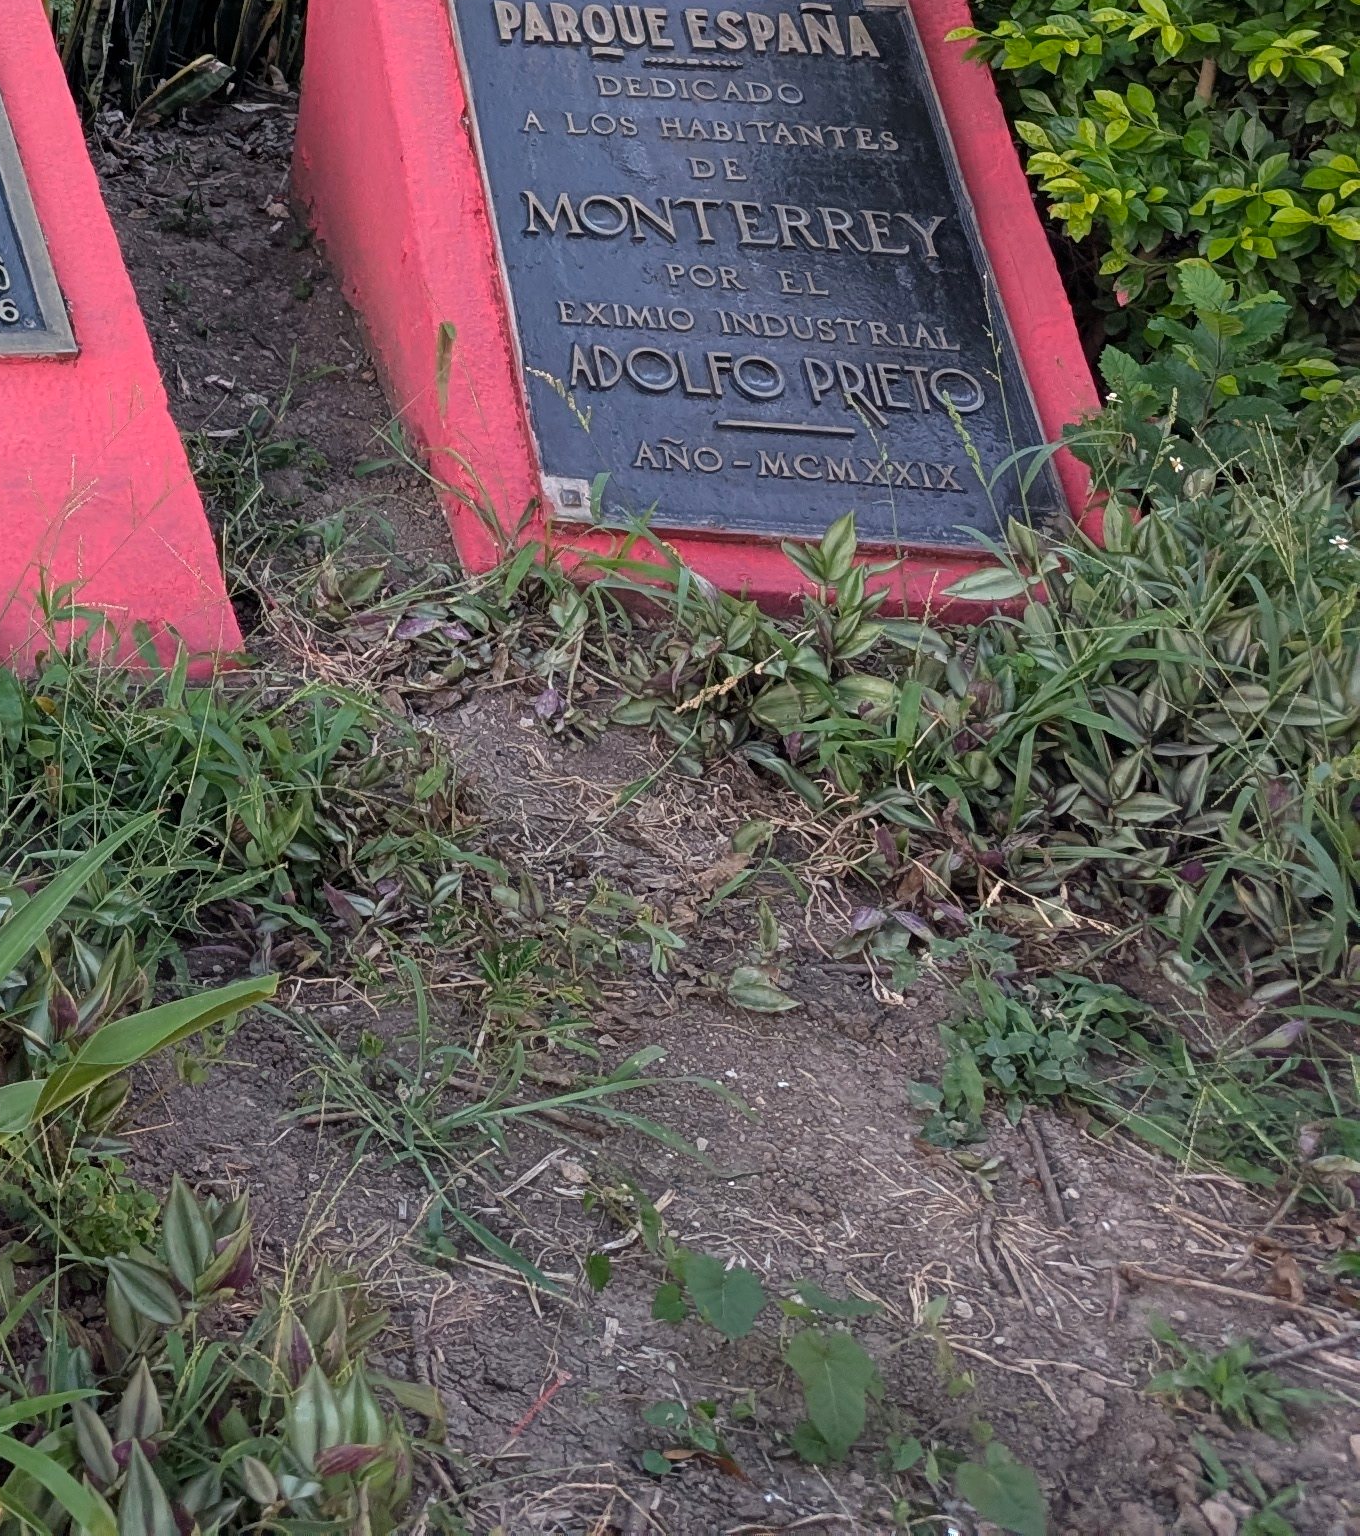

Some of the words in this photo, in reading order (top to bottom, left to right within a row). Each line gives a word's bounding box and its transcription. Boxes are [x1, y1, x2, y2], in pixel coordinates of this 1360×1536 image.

[494, 0, 675, 59] PARQUE
[684, 3, 880, 58] ESPAÑA
[595, 74, 805, 105] DEDICADO
[523, 110, 546, 133] A
[564, 111, 638, 136] LOS
[659, 117, 899, 151] HABITANTES
[687, 156, 748, 182] DE
[520, 190, 946, 261] MONTERREY
[666, 263, 748, 291] POR
[779, 268, 829, 297] EL
[557, 299, 695, 332] EXIMIO
[718, 309, 961, 352] INDUSTRIAL
[570, 343, 785, 401] ADOLFO
[804, 356, 986, 428] PRIETO
[632, 436, 723, 472] AÑO
[757, 450, 965, 492] MCMXXIX
